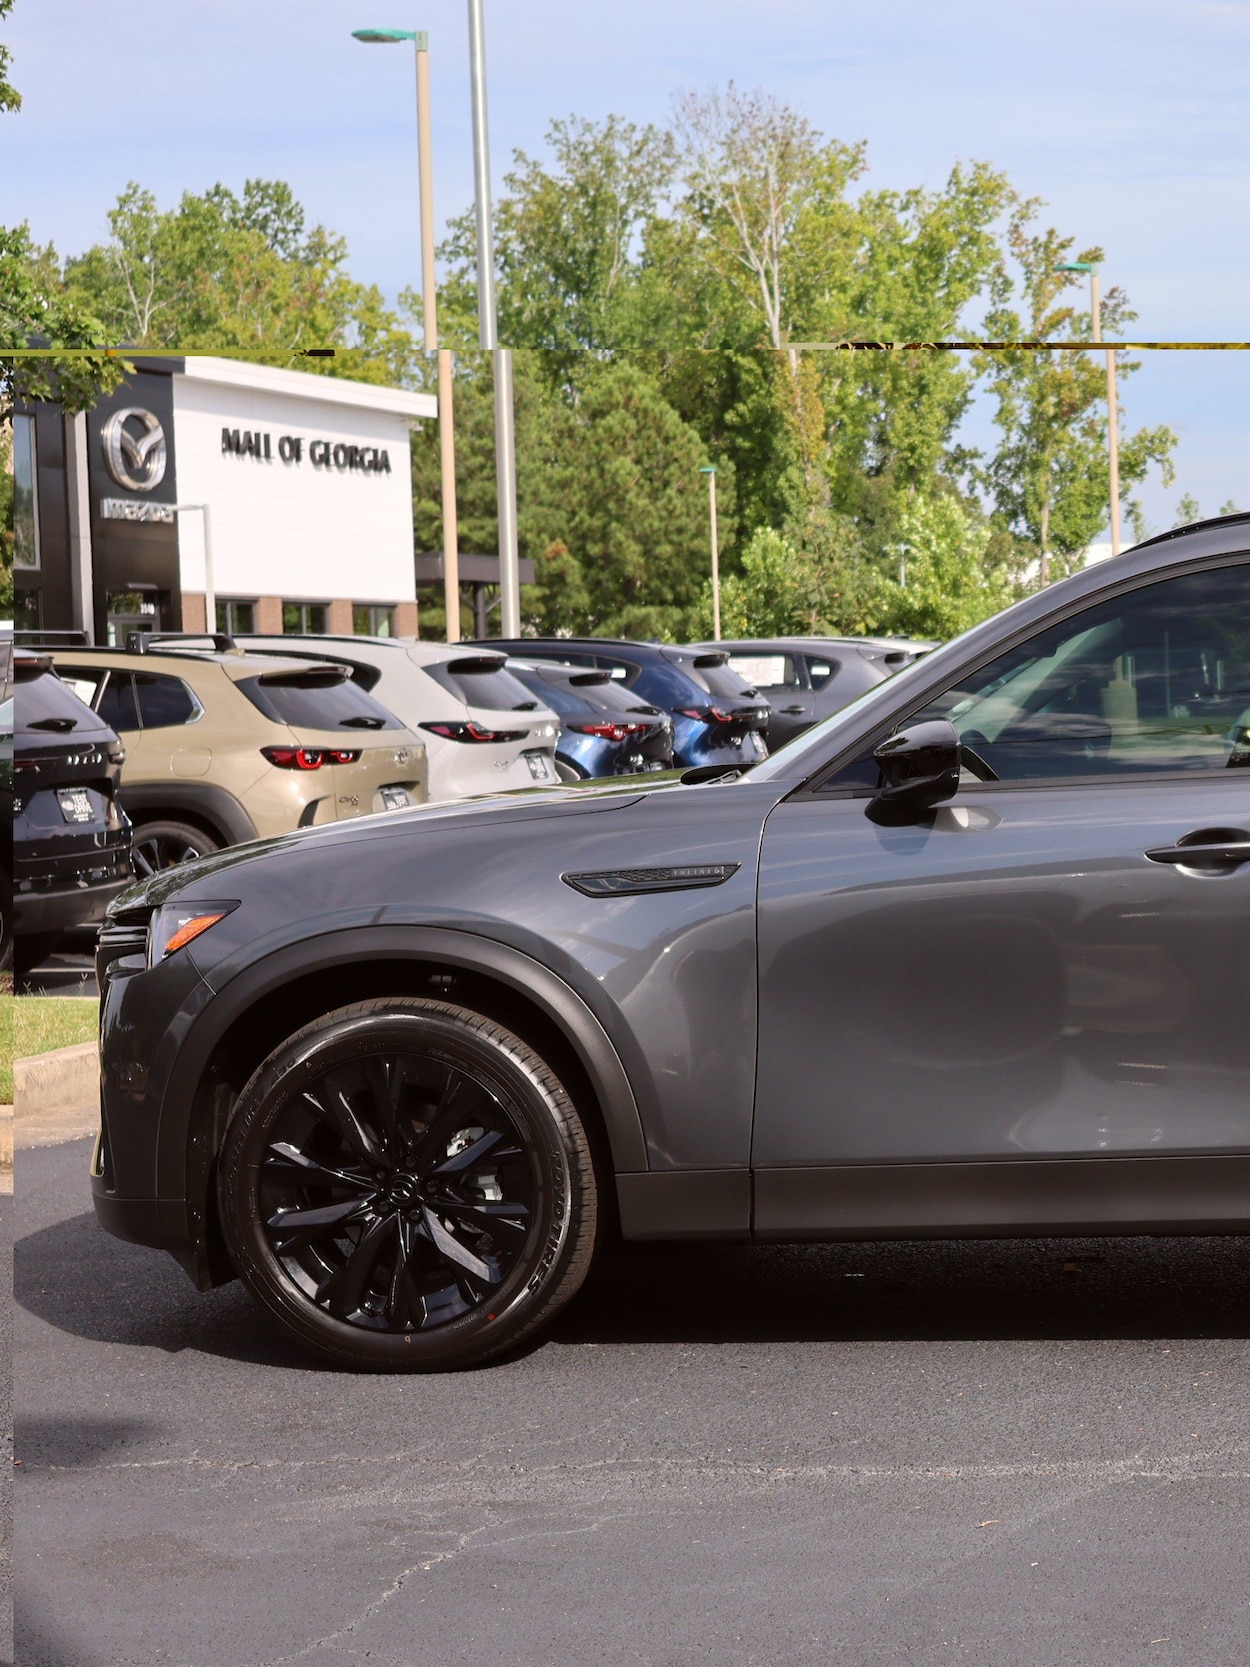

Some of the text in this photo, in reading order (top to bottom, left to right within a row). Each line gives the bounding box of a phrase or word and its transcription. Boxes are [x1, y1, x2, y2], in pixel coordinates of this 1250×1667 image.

[221, 428, 392, 474] MALL OF GEORGIA
